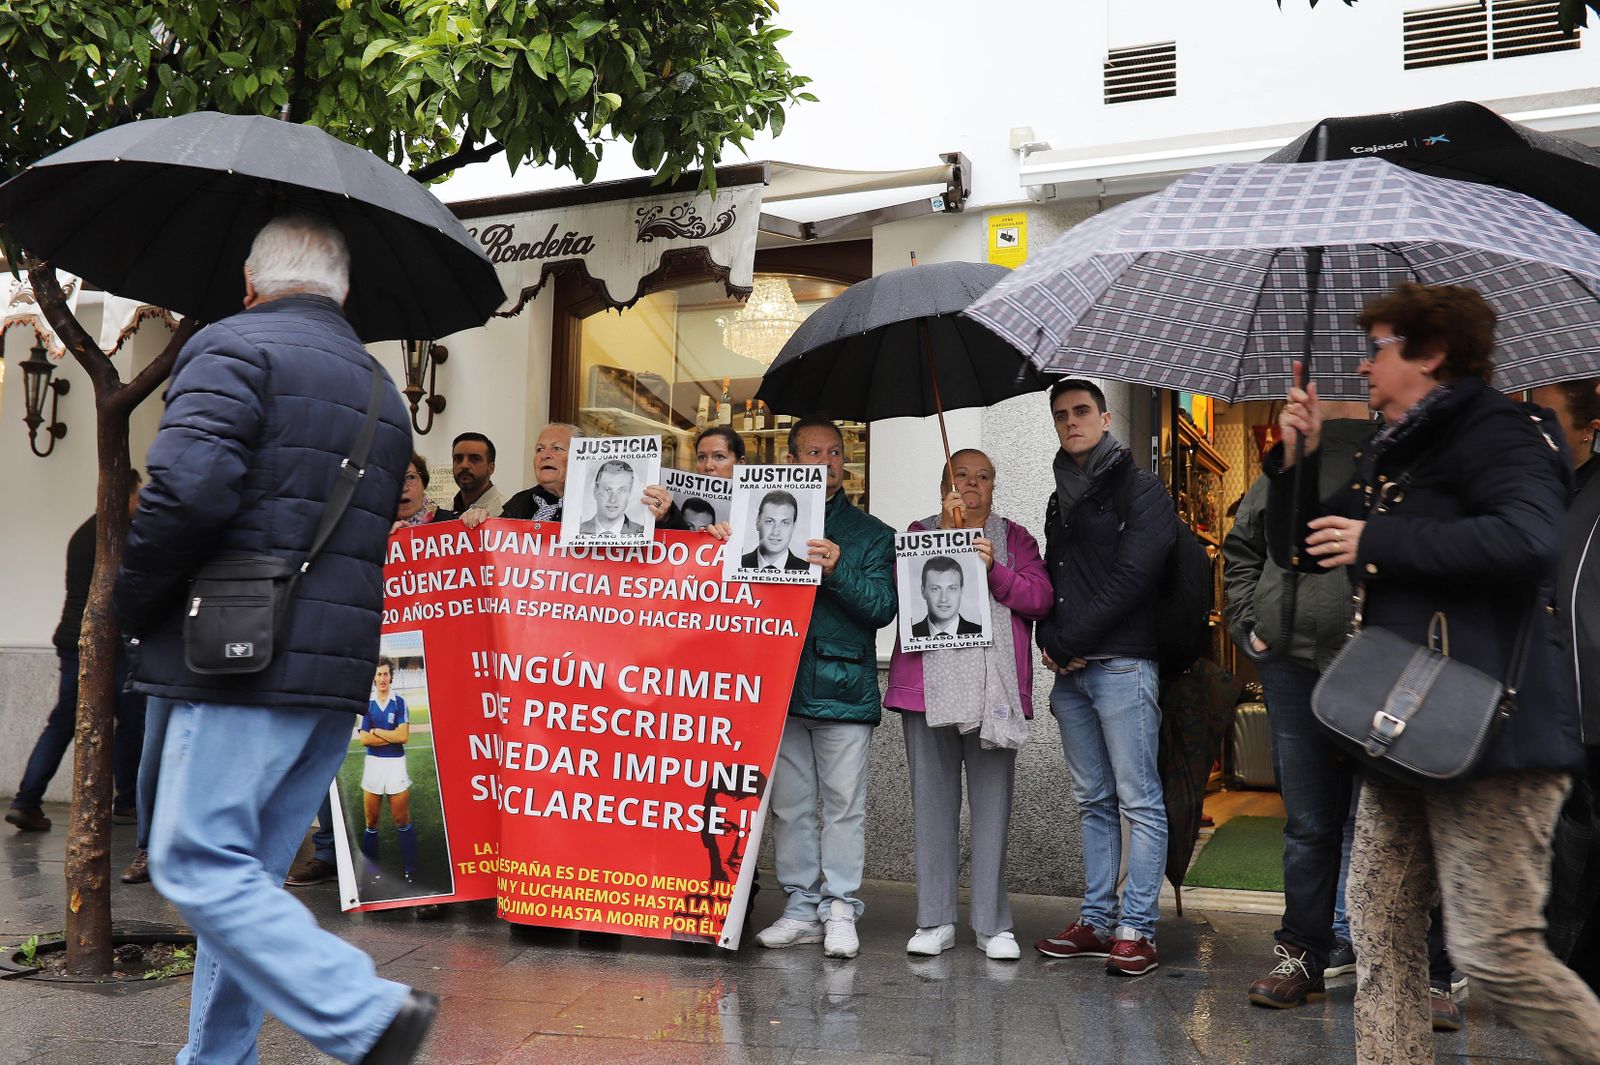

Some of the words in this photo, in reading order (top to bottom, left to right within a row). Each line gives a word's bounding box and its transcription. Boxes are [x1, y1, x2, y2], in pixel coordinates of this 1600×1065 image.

[1350, 140, 1408, 154] Cajasol
[480, 223, 596, 264] Rondeña
[576, 438, 658, 454] JUSTICIA
[666, 486, 681, 494] PARA
[682, 489, 701, 497] JUAN
[702, 492, 732, 501] HOLGAD
[740, 468, 823, 483] JUSTICIA
[384, 541, 406, 565] A
[410, 531, 475, 561] PARA
[479, 529, 542, 556] JUAN
[548, 534, 690, 566] HOLGADO
[945, 547, 980, 555] HOLGAD
[383, 567, 477, 599] GÜENZA
[498, 566, 611, 597] JUSTICIA
[618, 574, 762, 609] ESPAÑOLA,
[382, 609, 399, 625] 20
[402, 602, 445, 622] AÑOS
[448, 598, 475, 617] DE
[516, 599, 635, 626] ESPERANDO
[638, 610, 703, 630] HACER
[705, 614, 799, 637] JUSTICIA.
[925, 640, 993, 649] RESOLVERSE
[617, 665, 762, 703] CRIMEN
[522, 699, 742, 752] PRESCRIBIR,
[612, 752, 760, 794] IMPUNE
[474, 842, 493, 855] LA
[500, 857, 552, 878] ESPAÑA
[555, 865, 574, 880] ES
[578, 867, 600, 883] DE
[602, 870, 648, 888] TODO
[651, 875, 709, 894] MENOS
[457, 861, 476, 875] TE
[509, 879, 519, 894] Y
[520, 881, 630, 906] LUCHAREMOS
[633, 893, 686, 912] HASTA
[689, 899, 709, 914] LA
[713, 902, 730, 917] M
[550, 905, 602, 923] HASTA
[606, 910, 659, 929] MORIR
[663, 916, 696, 933] POR
